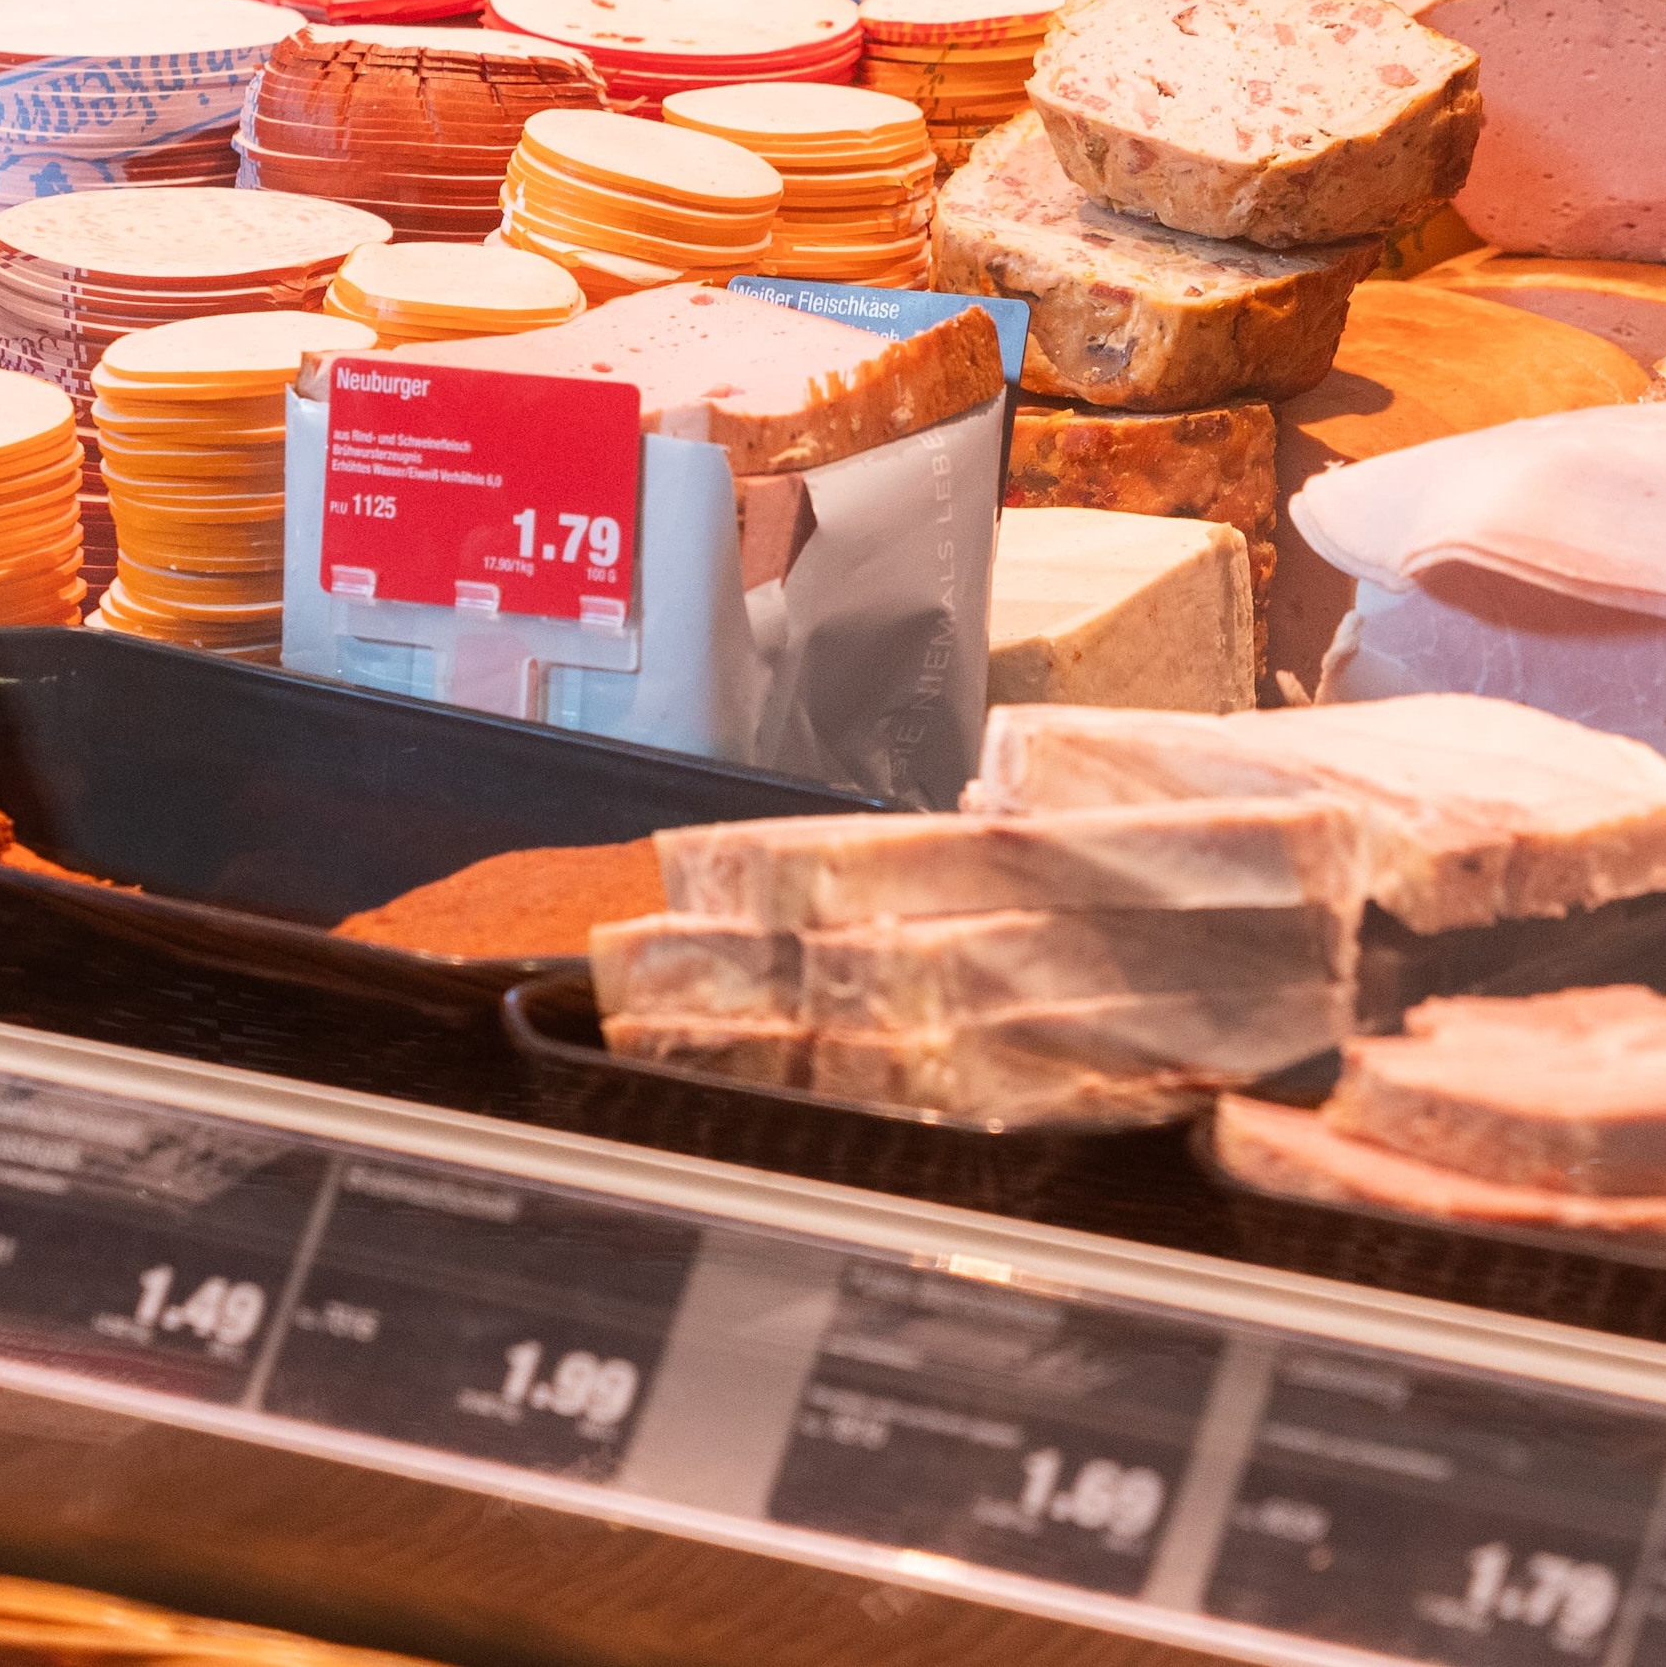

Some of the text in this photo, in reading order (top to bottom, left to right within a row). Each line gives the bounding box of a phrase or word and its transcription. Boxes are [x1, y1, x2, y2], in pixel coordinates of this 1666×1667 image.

[797, 290, 900, 320] Fleischkäse
[336, 367, 431, 401] Neuburger
[333, 429, 472, 454] aus Rind- und Schweinefleisch
[439, 469, 485, 486] Verhältnis
[920, 432, 953, 524] LEBE
[330, 494, 397, 520] PLU 1125
[513, 508, 620, 568] 1.79
[135, 1263, 267, 1348] 1.49
[502, 1338, 640, 1426] 1.99
[1466, 1539, 1619, 1652] 1.79
